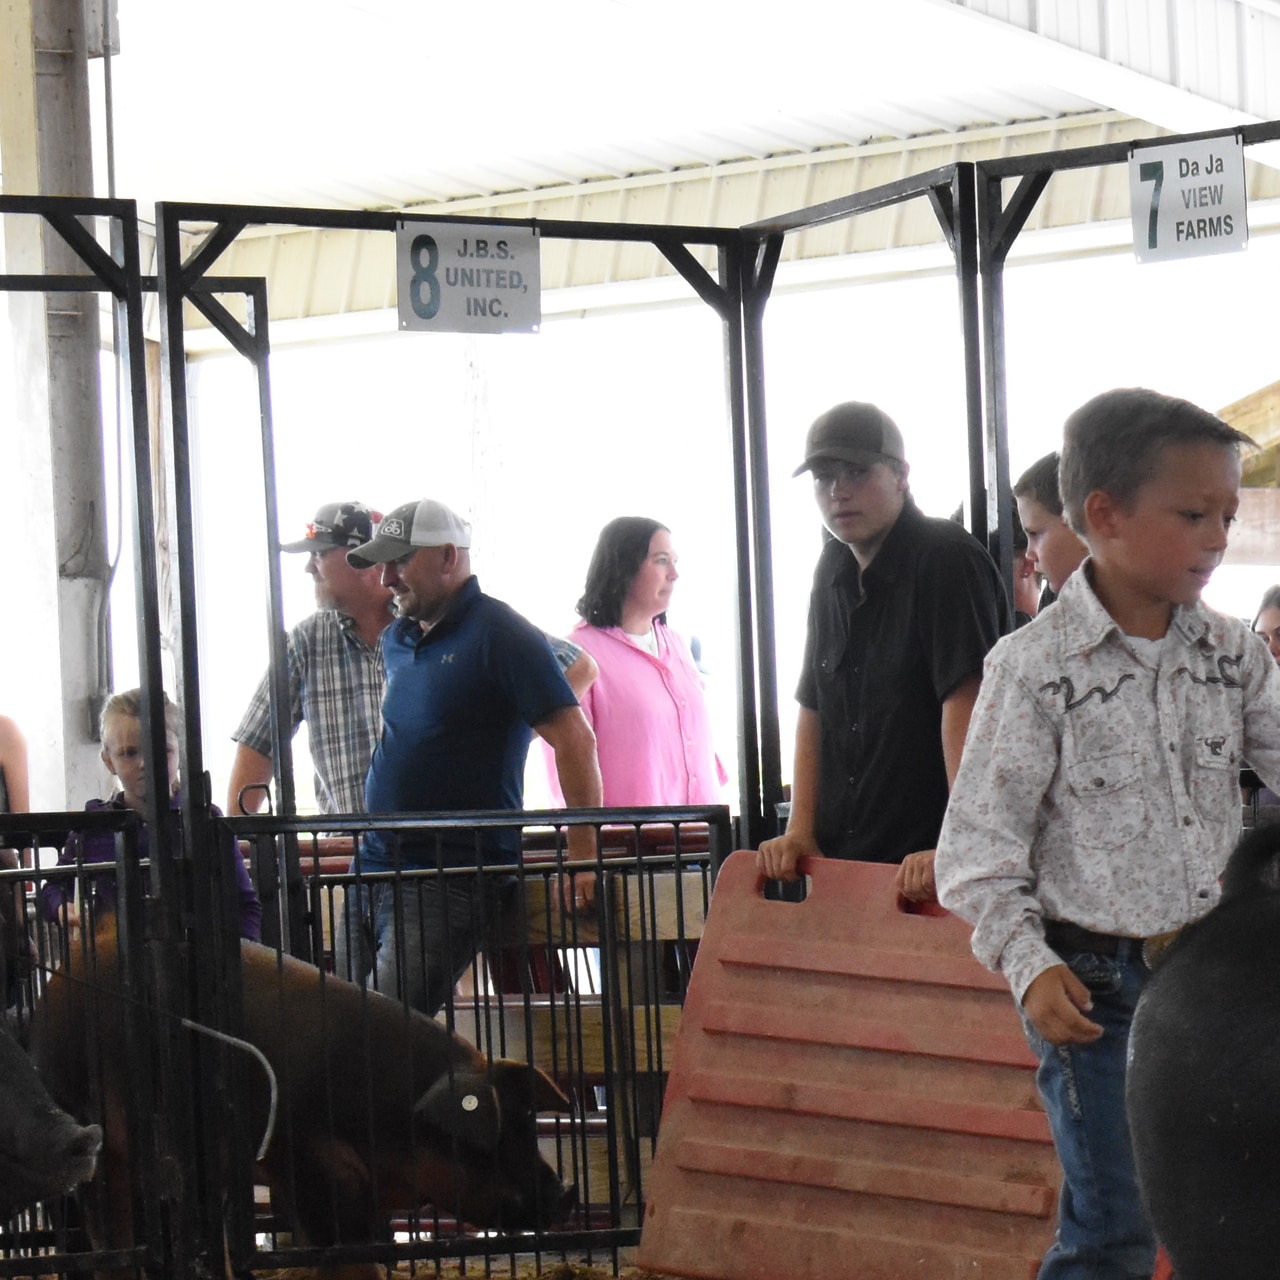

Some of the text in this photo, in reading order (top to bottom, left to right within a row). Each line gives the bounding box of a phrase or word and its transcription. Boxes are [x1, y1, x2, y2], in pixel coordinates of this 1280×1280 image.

[1178, 154, 1224, 179] Da Ja
[1139, 160, 1164, 250] 7
[1181, 184, 1224, 209] VIEW
[1175, 214, 1234, 242] FARMS
[457, 238, 515, 260] J.B.S.
[410, 233, 441, 320] 8
[445, 267, 528, 294] UNITED,
[466, 297, 509, 318] INC.
